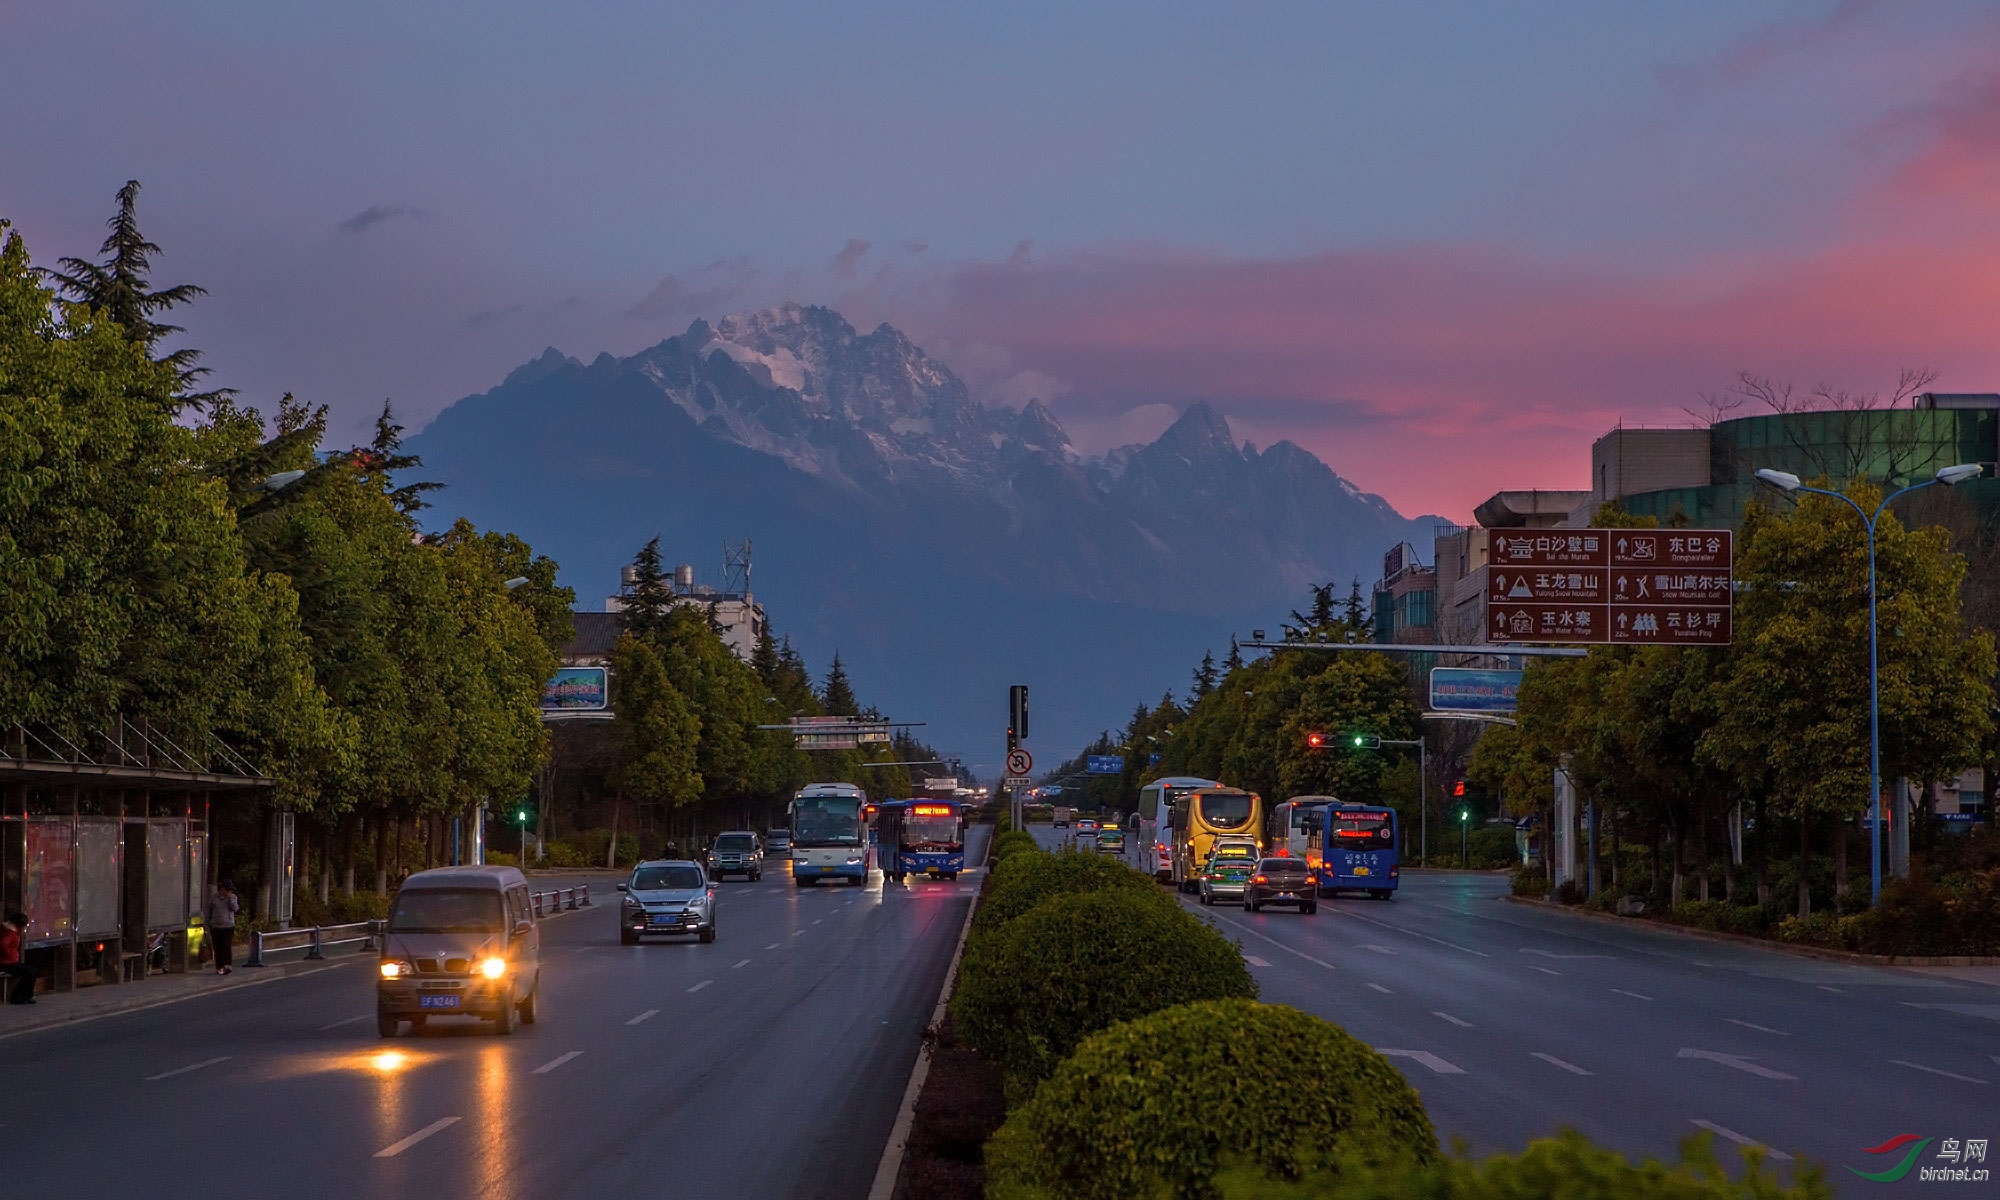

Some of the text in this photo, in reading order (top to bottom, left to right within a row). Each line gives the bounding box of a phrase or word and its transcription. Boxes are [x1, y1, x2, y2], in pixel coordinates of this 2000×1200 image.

[1537, 536, 1599, 552] 白沙壁画
[1669, 537, 1721, 553] 东巴谷
[1535, 573, 1598, 589] 玉龙雪山
[1655, 574, 1729, 590] 雪山高尔夫
[1541, 610, 1591, 627] 玉水寨
[1666, 612, 1722, 629] 云杉坪
